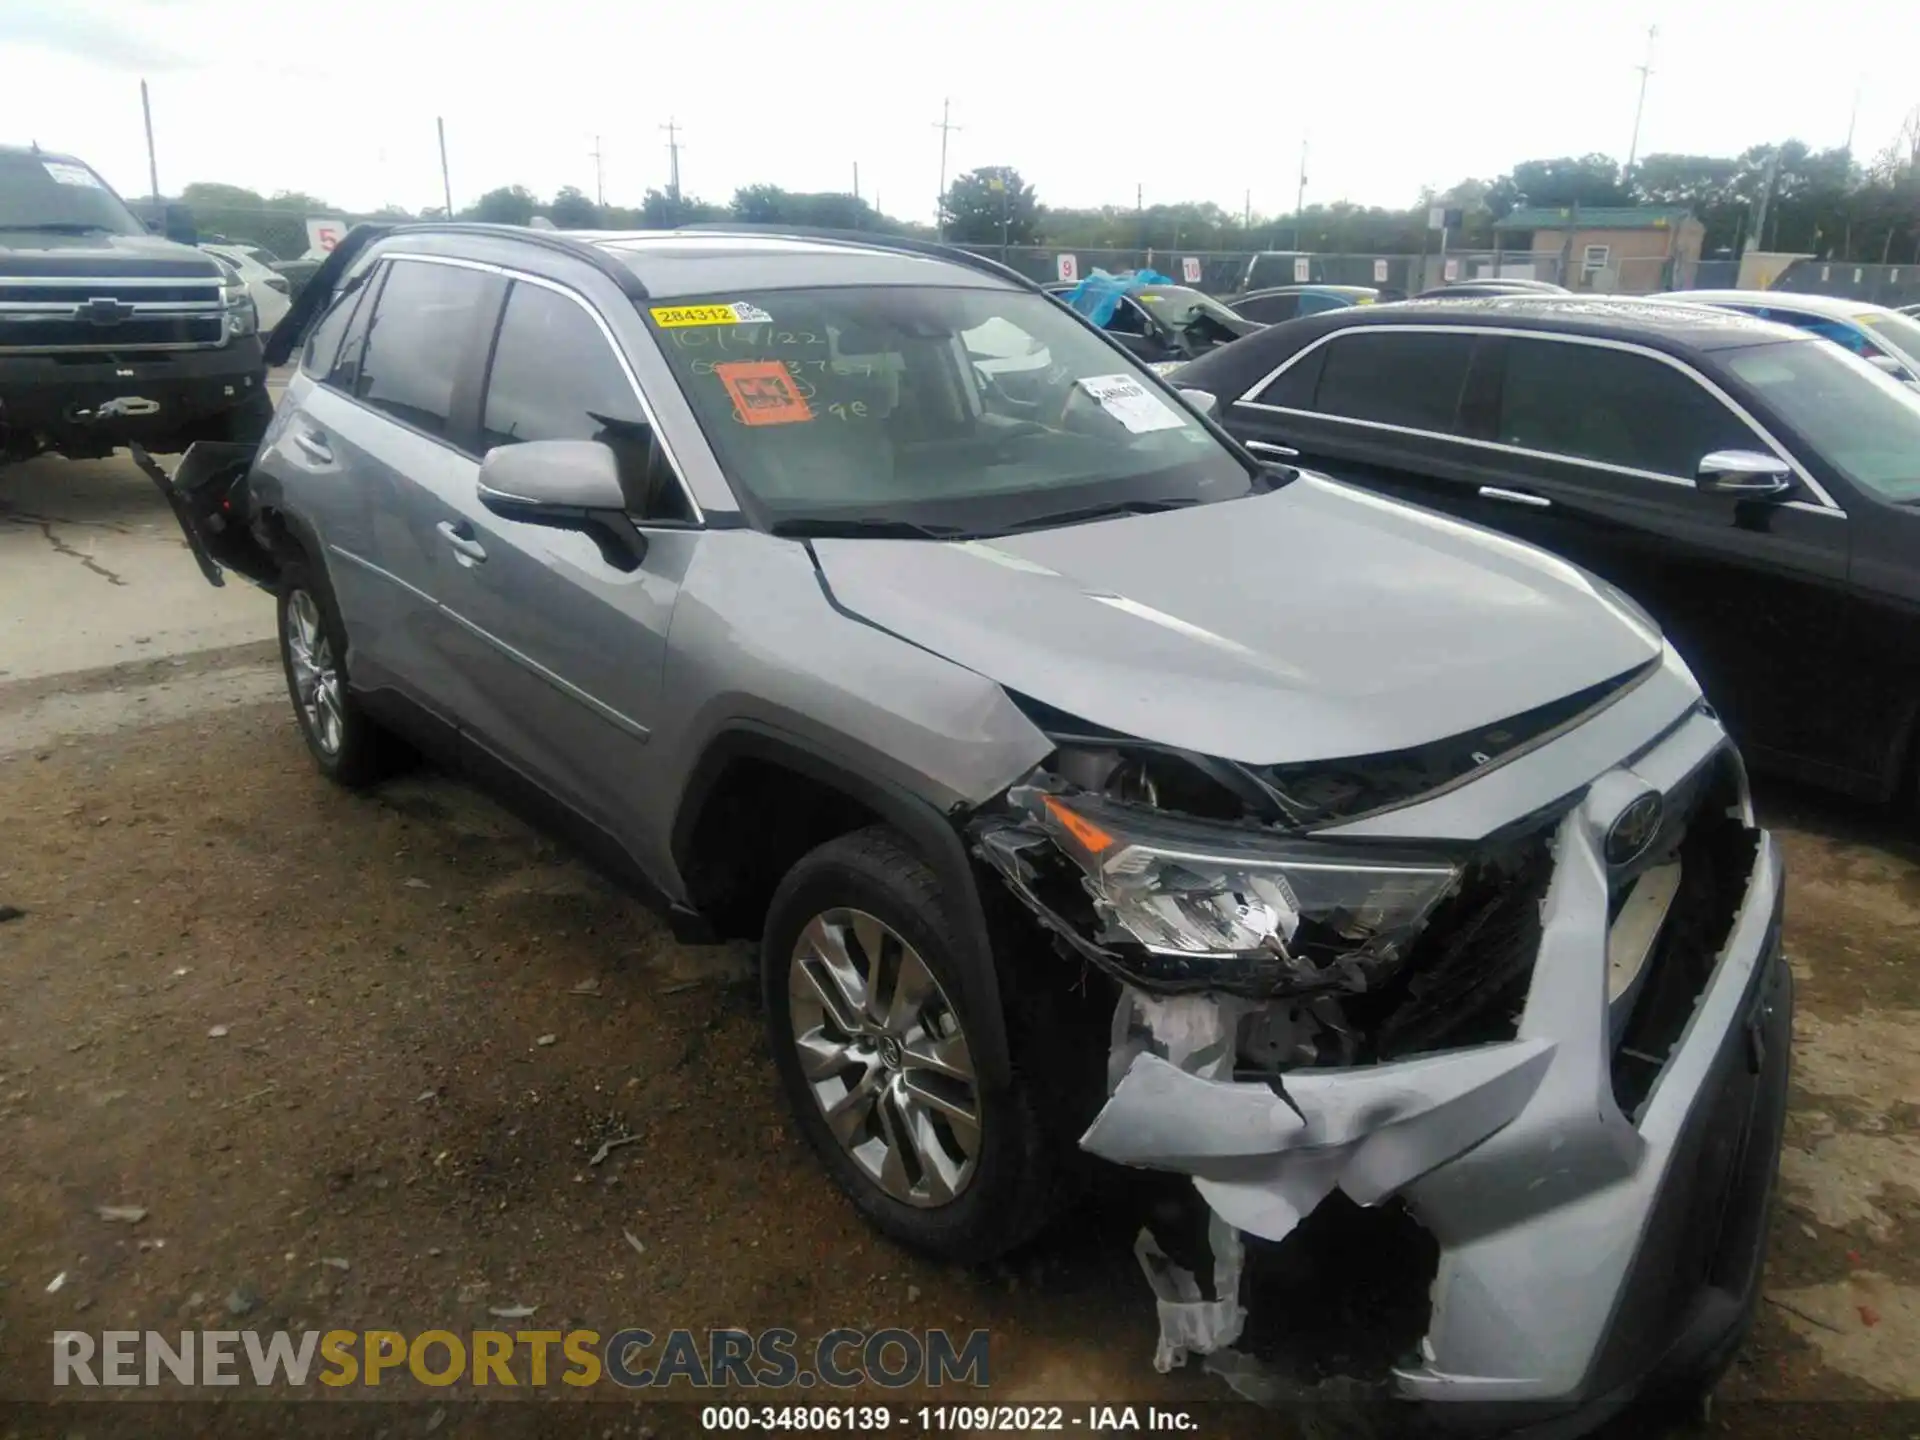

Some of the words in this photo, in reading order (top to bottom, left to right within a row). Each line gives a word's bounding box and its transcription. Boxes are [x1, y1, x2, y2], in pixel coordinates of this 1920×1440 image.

[318, 227, 338, 252] 5
[1062, 260, 1073, 277] 9
[657, 307, 733, 323] 284312
